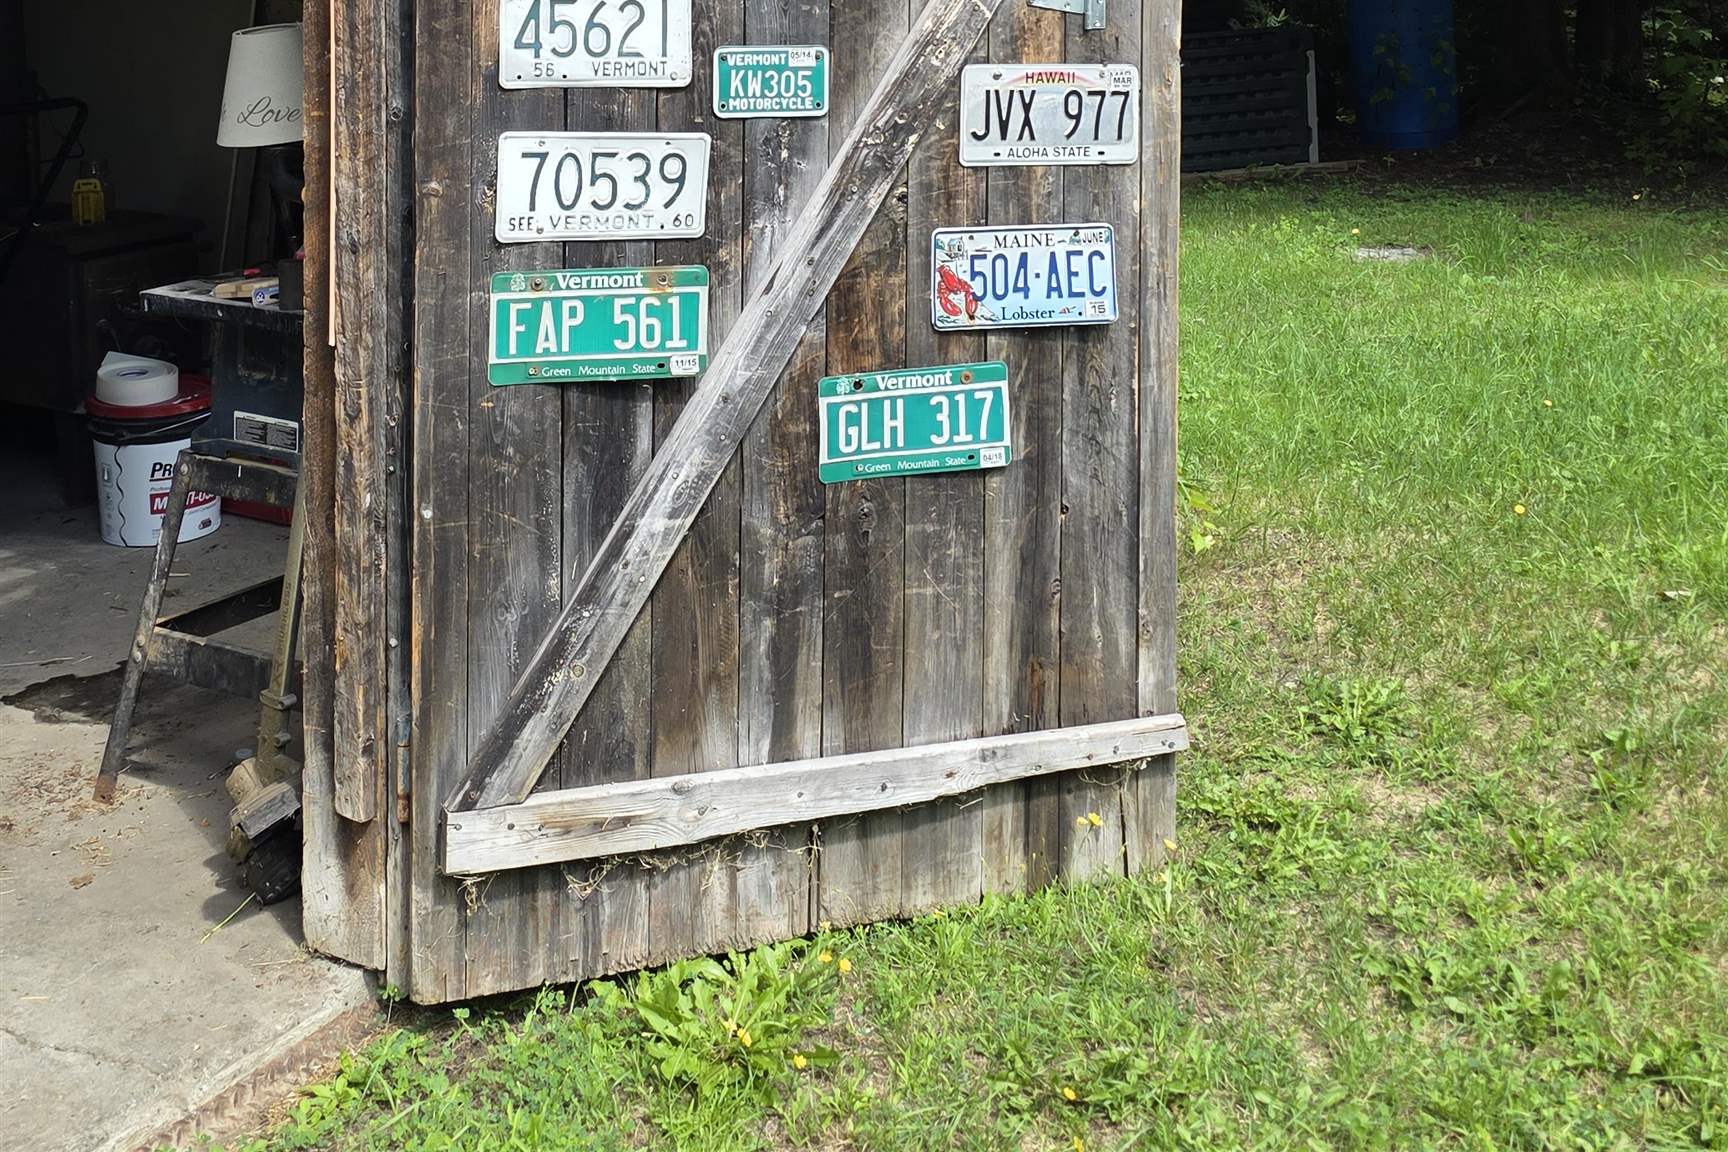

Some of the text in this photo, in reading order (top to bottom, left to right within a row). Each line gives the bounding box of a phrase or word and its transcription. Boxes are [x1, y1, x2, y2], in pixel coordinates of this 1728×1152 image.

[514, 0, 668, 59] 45621
[727, 53, 787, 66] VERMONT
[534, 61, 667, 77] 56 VERMONT
[730, 69, 813, 98] KW305
[1025, 72, 1076, 84] HAWAII
[1113, 77, 1132, 85] MAR
[237, 96, 303, 127] Love
[728, 97, 814, 110] MOTORCYCLE
[970, 89, 1130, 142] JVX 977
[1007, 146, 1091, 158] ALOHA STATE
[521, 151, 687, 212] 70539
[509, 214, 694, 231] SEE VERMONT 60
[994, 232, 1056, 249] MAINE
[1082, 231, 1104, 243] JUNE
[556, 272, 643, 290] Vermont
[1001, 305, 1055, 321] Lobster
[1090, 304, 1106, 314] 15
[508, 295, 688, 355] FAP 561
[541, 362, 656, 377] Green Mountain State
[876, 371, 953, 390] Vermont
[838, 390, 994, 454] GLH 317
[865, 456, 966, 473] Green Mountain State
